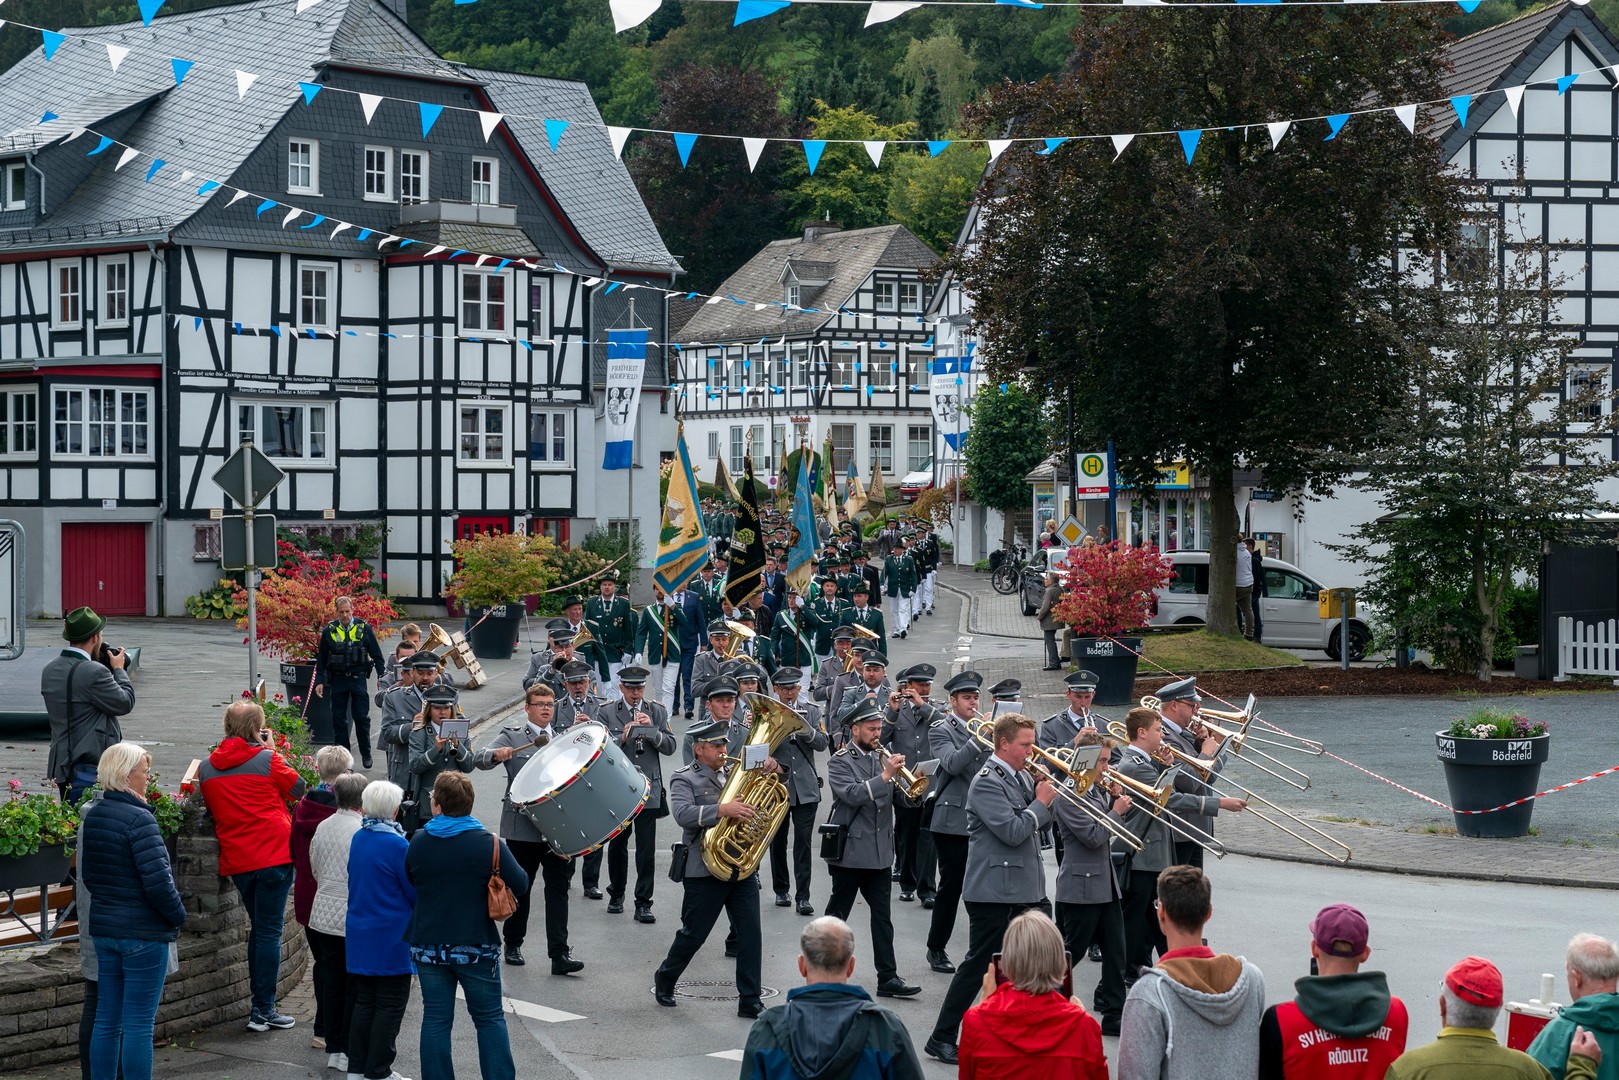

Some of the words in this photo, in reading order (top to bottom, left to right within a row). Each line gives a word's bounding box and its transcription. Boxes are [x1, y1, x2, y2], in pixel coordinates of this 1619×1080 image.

[519, 523, 524, 536] 3
[1493, 750, 1532, 760] Bödefeld
[1298, 1031, 1315, 1048] SV
[1328, 1047, 1368, 1065] RÖDLITZ
